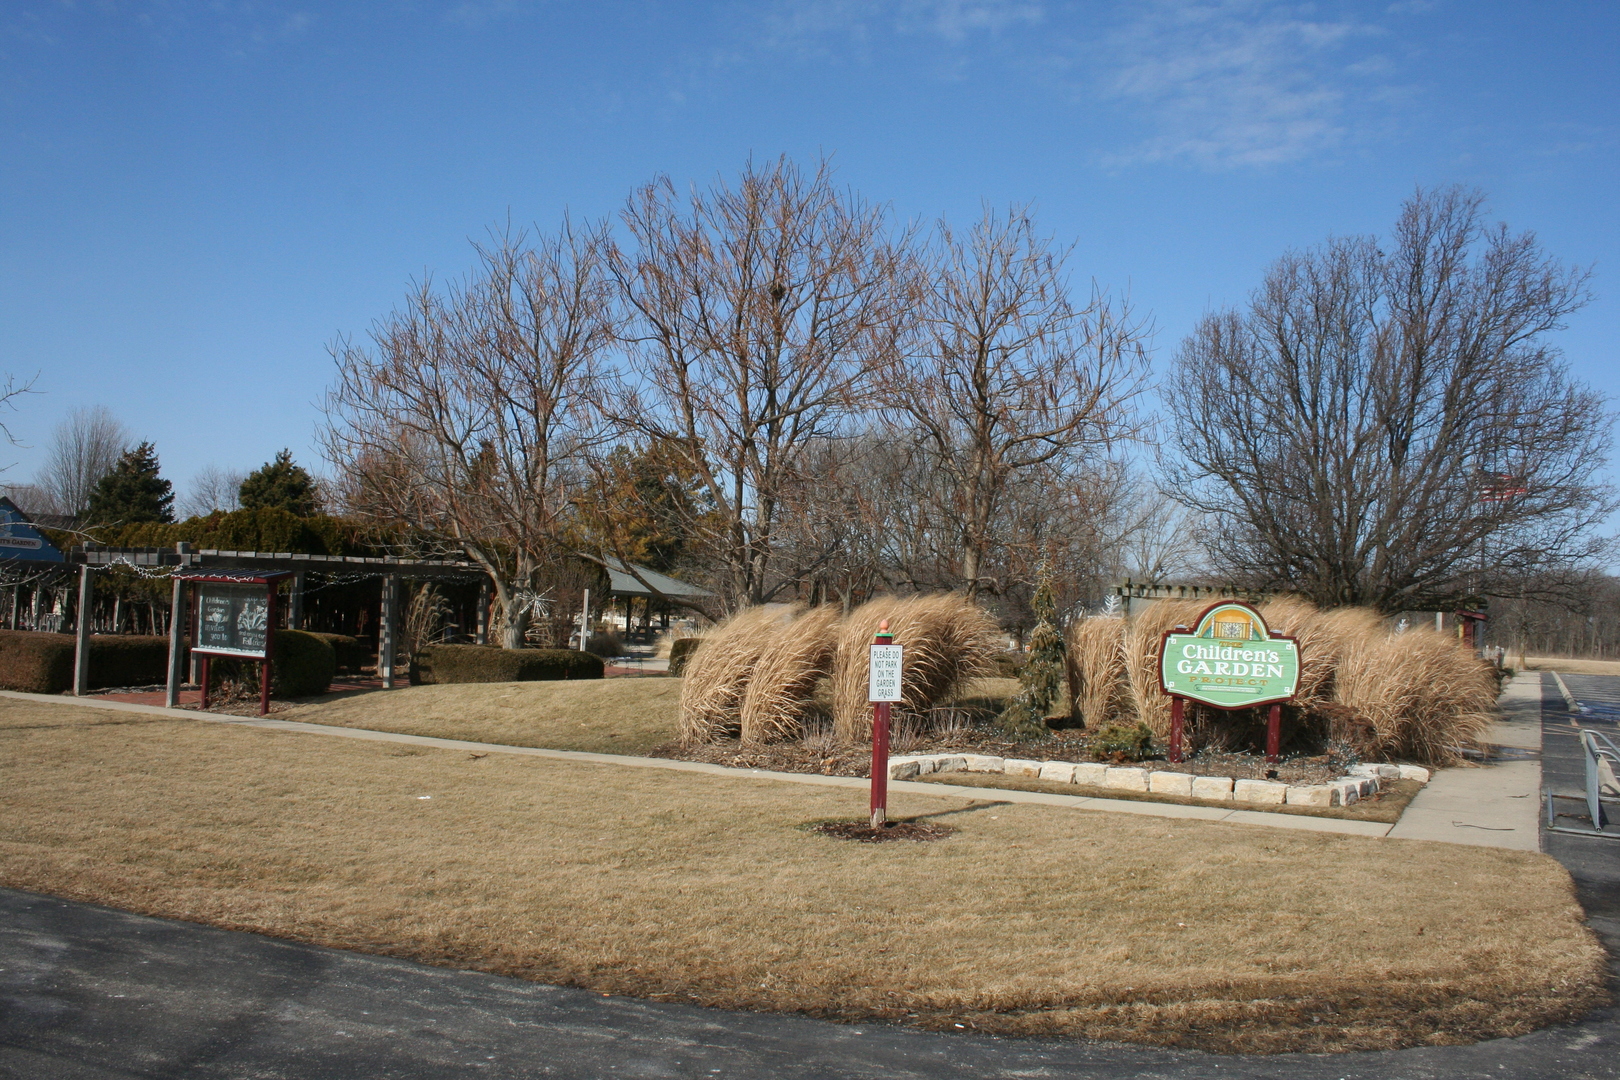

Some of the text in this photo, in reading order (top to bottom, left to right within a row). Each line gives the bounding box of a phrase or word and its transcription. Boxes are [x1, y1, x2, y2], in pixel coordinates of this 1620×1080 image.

[874, 651, 891, 659] PLEASE
[1182, 644, 1279, 663] Children's
[1177, 659, 1284, 678] GARDEN
